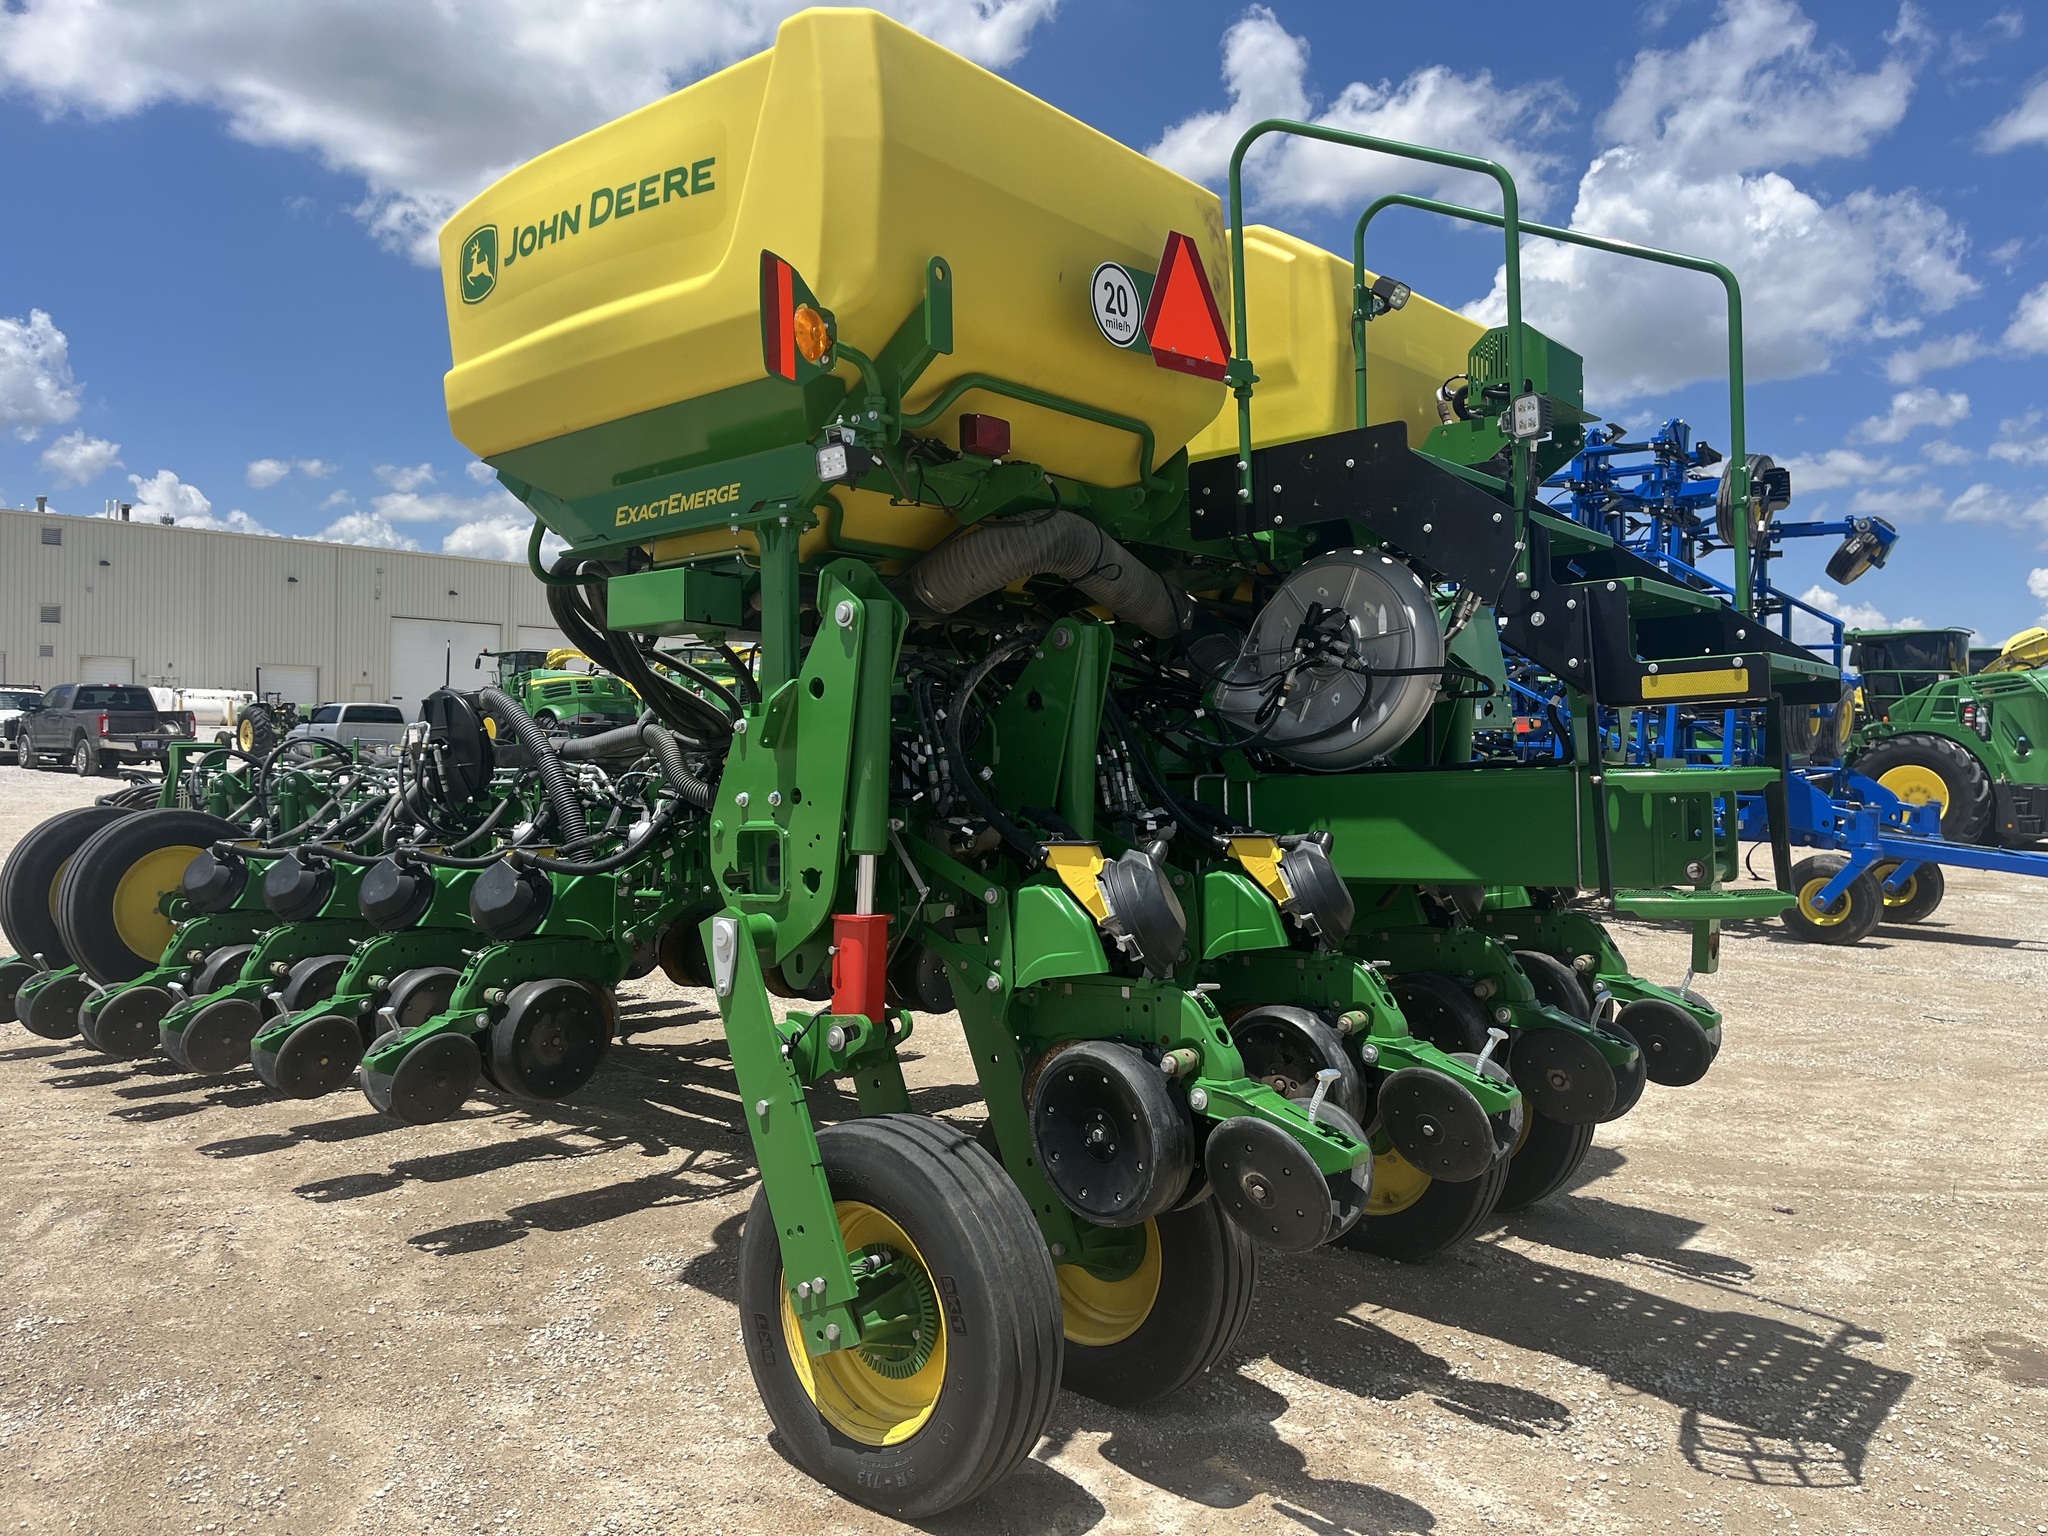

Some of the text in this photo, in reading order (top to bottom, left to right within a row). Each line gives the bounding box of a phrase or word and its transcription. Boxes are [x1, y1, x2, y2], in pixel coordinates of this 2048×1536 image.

[504, 157, 716, 266] JOHN DEERE
[1103, 281, 1128, 317] 20
[1105, 318, 1131, 333] mile/h
[941, 1276, 967, 1335] BKT
[754, 1313, 776, 1366] BKT
